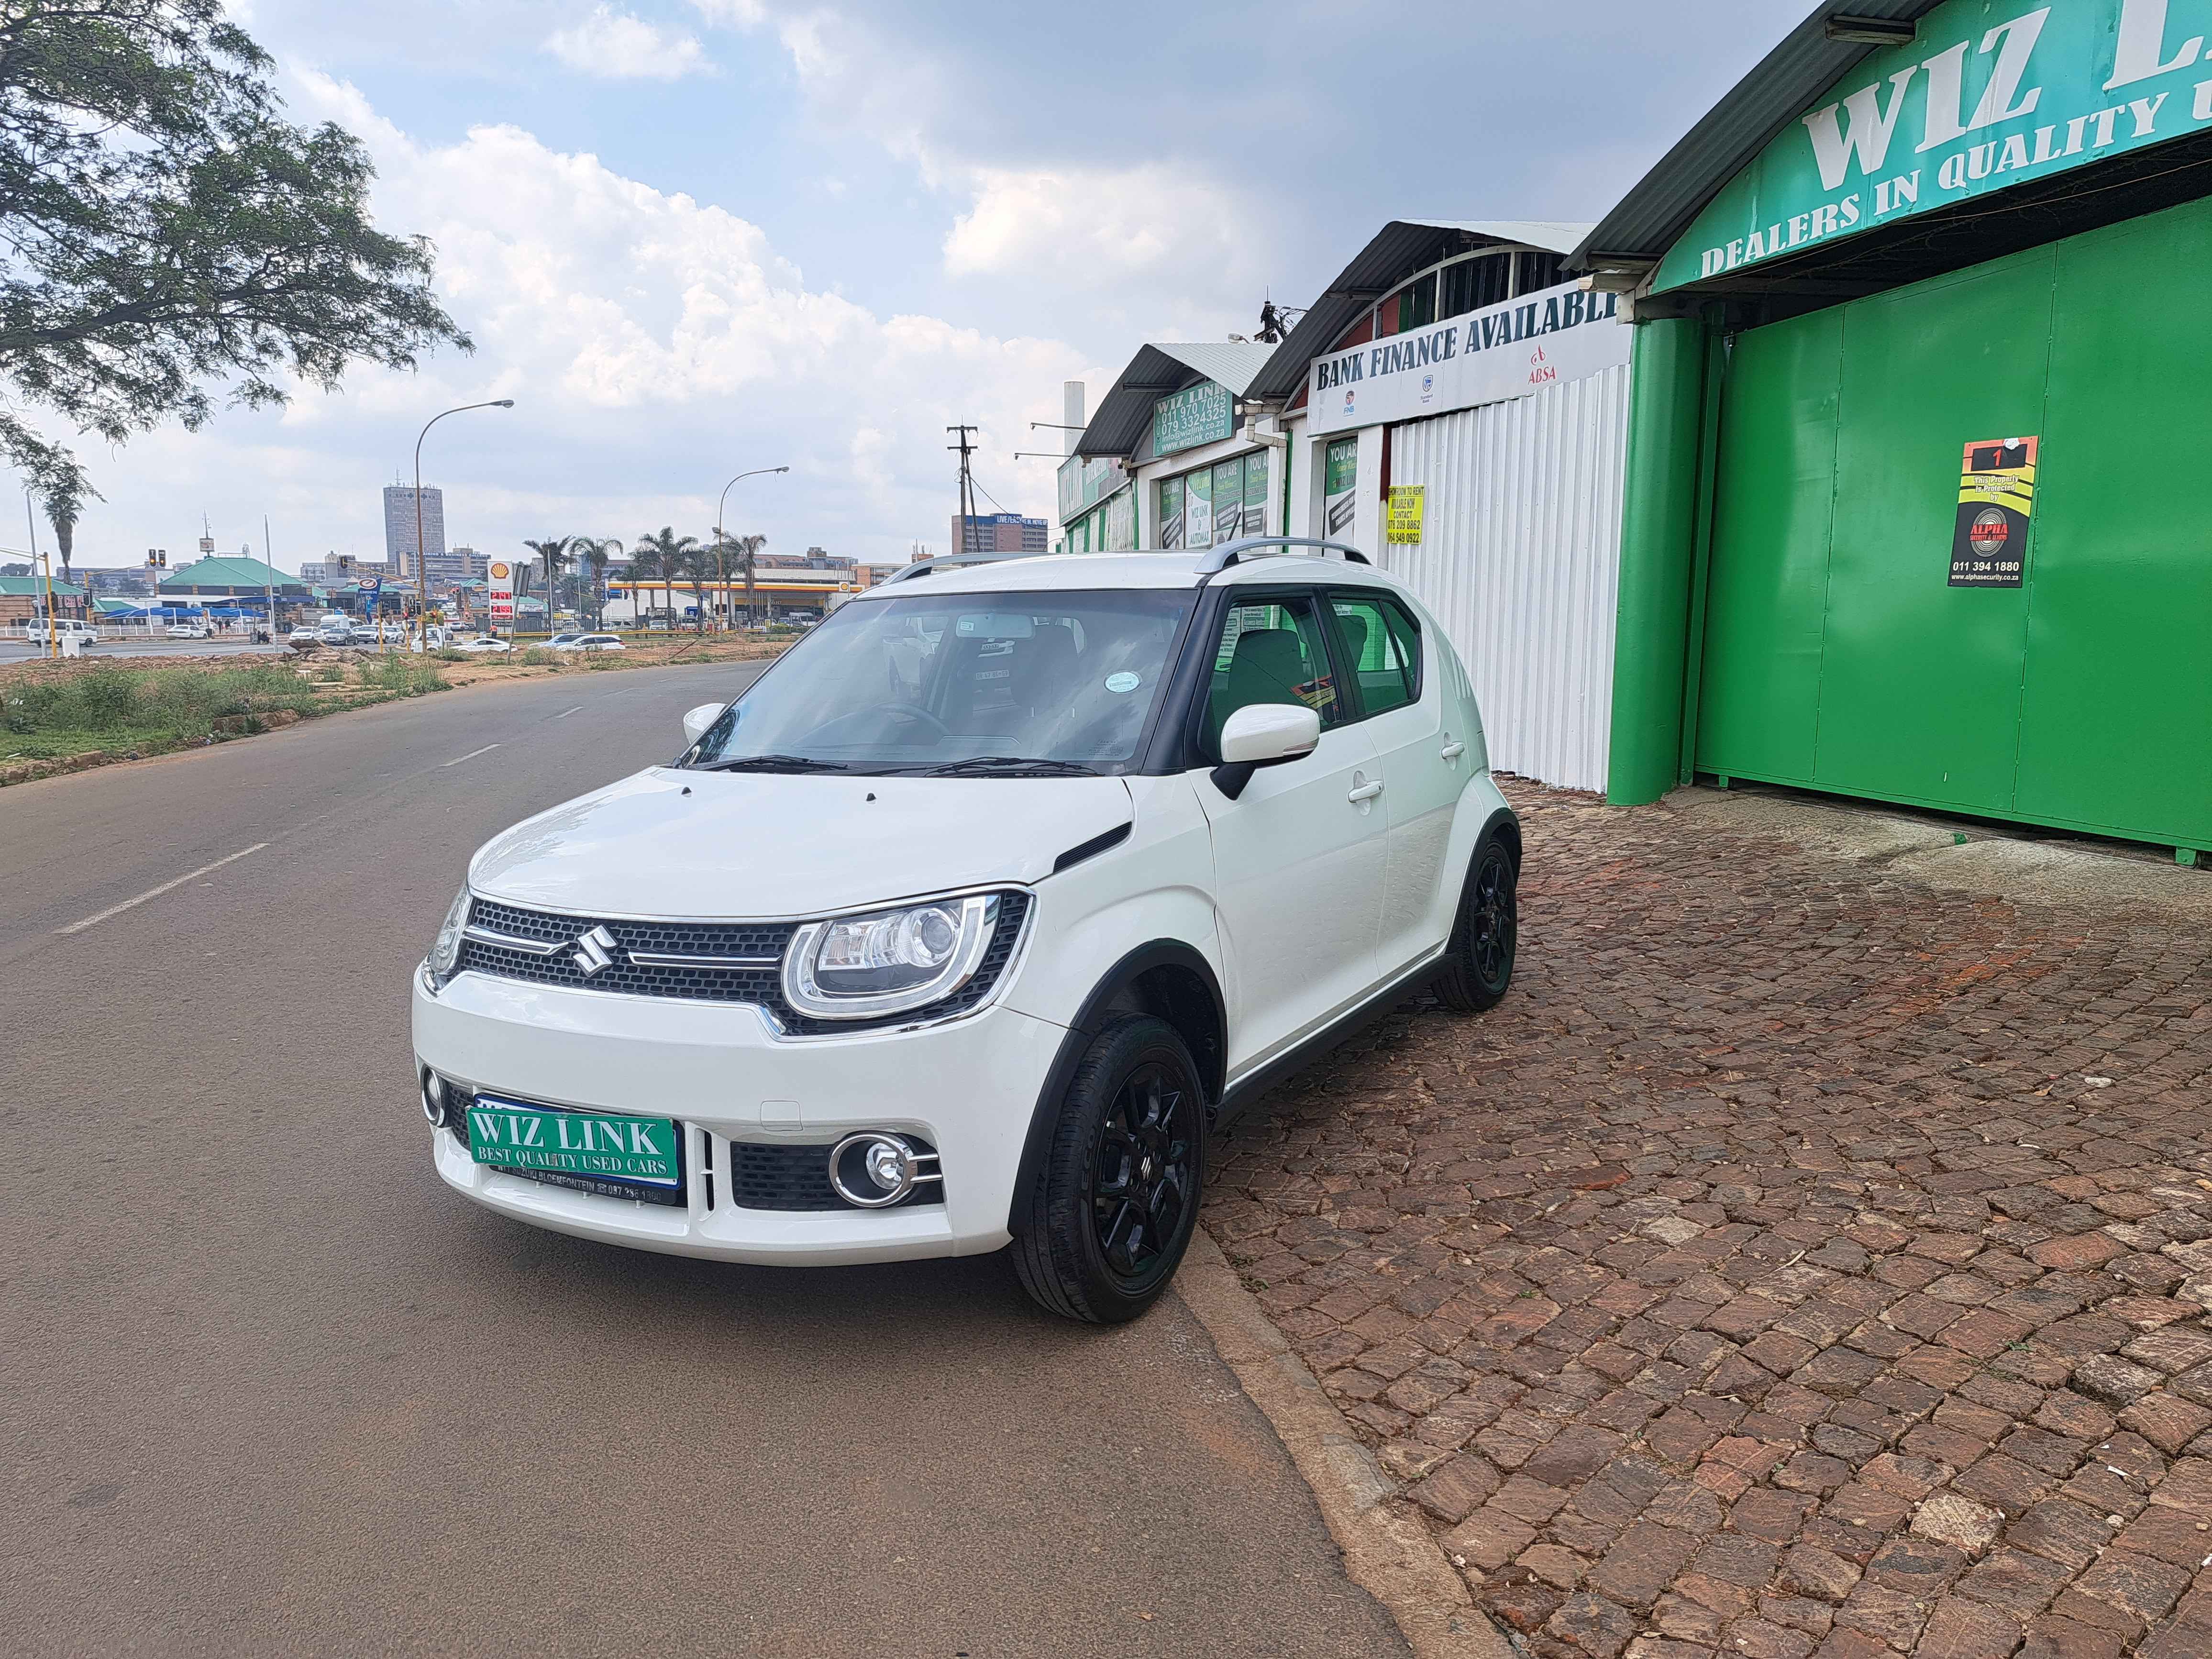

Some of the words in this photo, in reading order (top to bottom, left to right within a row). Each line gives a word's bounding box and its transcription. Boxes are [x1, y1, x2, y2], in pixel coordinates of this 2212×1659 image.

[1802, 7, 2051, 191] WIZ
[1700, 193, 1860, 279] DEALERS
[1874, 168, 1921, 217] IN
[1938, 92, 2169, 189] QUALITY
[1317, 352, 1363, 391] BANK
[1369, 326, 1458, 377] FINANCE
[1528, 366, 1556, 385] ABSA
[1157, 395, 1183, 414] WIZ
[1162, 409, 1177, 424] 011
[1181, 403, 1197, 418] 970
[1201, 393, 1226, 411] 7025
[1343, 406, 1355, 414] FNB
[1162, 421, 1179, 435] 079
[1182, 405, 1226, 429] 3324325
[1162, 420, 1225, 442] info@wizlink.co.za
[1162, 428, 1225, 452] www.wizlink.co.za
[1330, 445, 1345, 463] YOU
[1347, 443, 1356, 459] AR
[1217, 466, 1227, 480] YOU
[1228, 462, 1237, 477] ARE
[1250, 456, 1261, 471] YOU
[1974, 476, 1989, 484] This
[1990, 475, 2019, 484] Property
[1162, 483, 1171, 496] YOU
[1413, 487, 1424, 495] RENT
[1983, 484, 2015, 492] Protected
[1407, 498, 1415, 509] NOW
[1990, 493, 1999, 501] by
[1394, 510, 1413, 519] CONTACT
[1396, 520, 1405, 529] 209
[1407, 520, 1420, 530] 8862
[1970, 524, 2008, 534] ALPHA
[1190, 531, 1209, 545] AUTOMAX
[1396, 533, 1405, 543] 549
[1406, 533, 1419, 543] 0922
[1953, 561, 1969, 571] 011
[1972, 562, 1991, 571] 394
[1994, 562, 2019, 571] 1880
[472, 1112, 546, 1148] WIZ
[555, 1118, 664, 1155] LINK
[477, 1146, 513, 1163] BEST
[516, 1150, 578, 1169] QUALITY
[582, 1155, 623, 1172] USED
[627, 1158, 668, 1175] CARS
